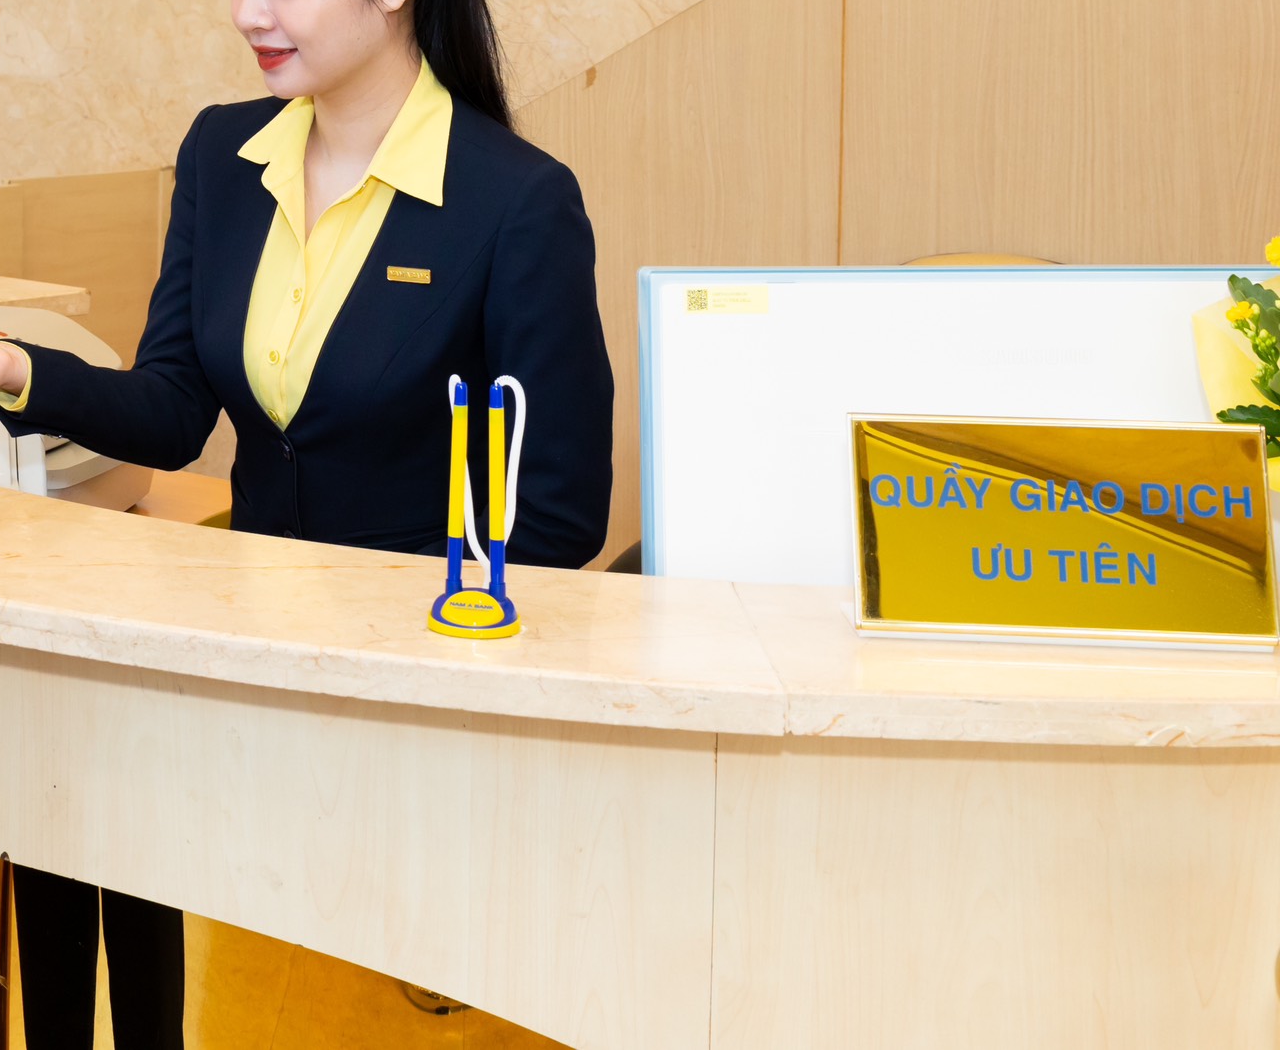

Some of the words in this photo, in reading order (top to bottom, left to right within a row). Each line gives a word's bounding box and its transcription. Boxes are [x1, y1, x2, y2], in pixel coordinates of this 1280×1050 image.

[869, 462, 992, 509] QUẦY
[1010, 477, 1125, 515] GIAO
[1140, 481, 1253, 525] DỊCH
[971, 542, 1032, 582] ƯU
[1049, 543, 1158, 586] TIÊN
